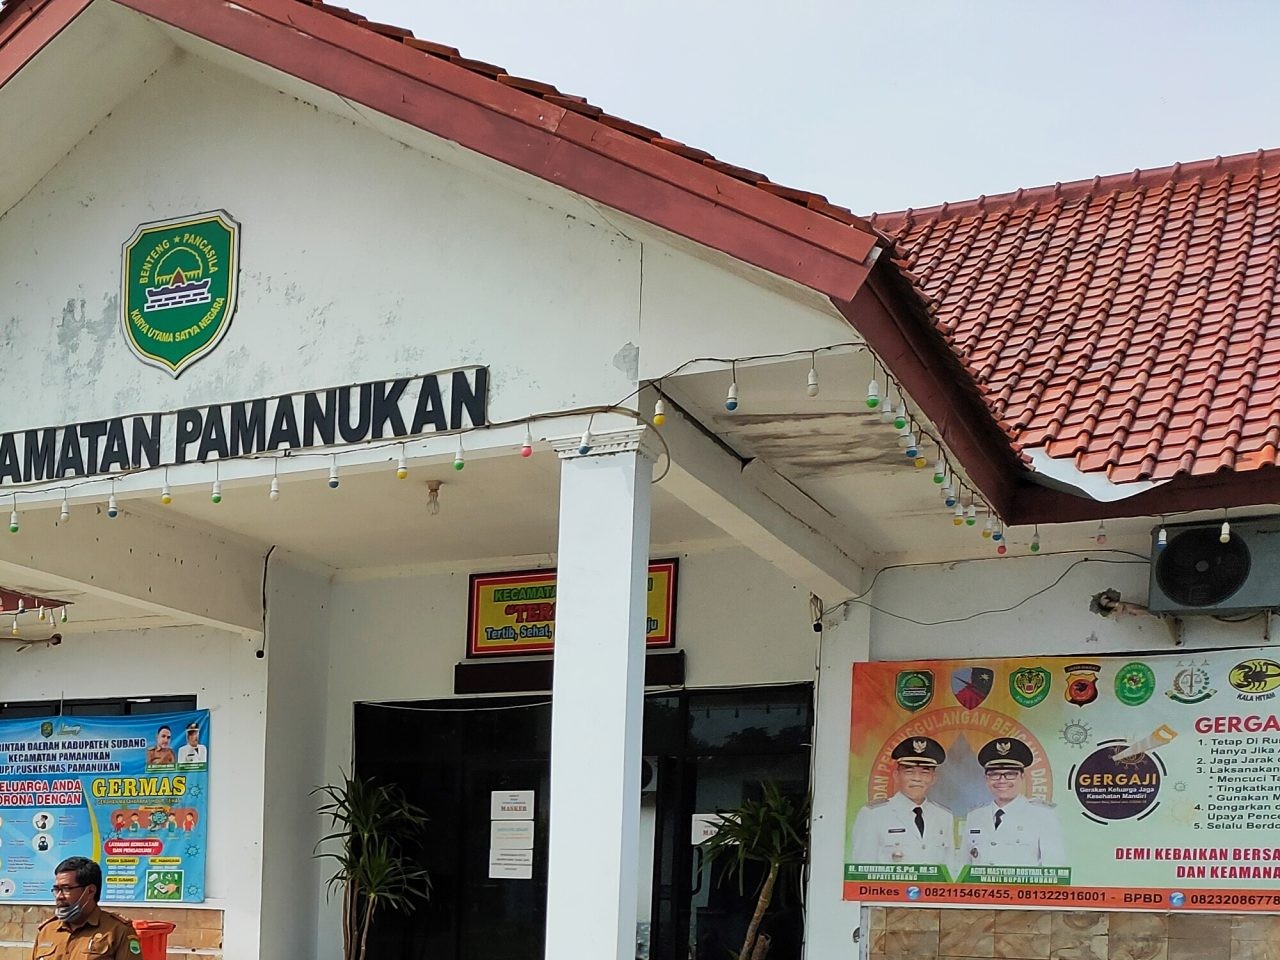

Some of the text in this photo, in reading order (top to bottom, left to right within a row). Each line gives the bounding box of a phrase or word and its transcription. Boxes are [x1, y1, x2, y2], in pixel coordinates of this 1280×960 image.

[139, 233, 218, 284] BENTENG PANCASILA
[130, 297, 225, 343] KARYA UTAMA SATYA NEGARA
[176, 367, 489, 462] PAMANUKAN
[494, 585, 556, 602] KECAMATA
[486, 626, 518, 641] Tertib,
[520, 624, 552, 639] Sehat,
[1236, 691, 1276, 701] KALA HITAM
[27, 741, 60, 751] DAERAH
[61, 740, 109, 750] KABUPATEN
[111, 738, 146, 749] SUBANG
[1211, 738, 1242, 747] Tetap
[8, 752, 111, 763] KECAMATAN PAMANUKAN
[1211, 748, 1246, 756] Hanya
[1210, 757, 1237, 767] Jaga
[1241, 756, 1273, 764] Jarak
[0, 762, 120, 774] UPT PUSKESMAS PAMANUKAN
[1210, 765, 1280, 774] Laksanakan
[1079, 774, 1157, 785] GERGAJI
[1217, 774, 1266, 783] Mencuci
[51, 780, 82, 791] ANDA
[92, 776, 187, 798] GERMAS
[873, 776, 888, 800] DAN
[1108, 786, 1137, 794] Keluarga
[37, 793, 82, 805] DENGAN
[1216, 793, 1269, 801] Gunakan
[1194, 803, 1204, 811] 4.
[1208, 803, 1271, 812] Dengarkan
[1207, 813, 1243, 821] Upaya
[1207, 822, 1243, 830] Selalu
[1115, 848, 1151, 860] DEMI
[1154, 848, 1228, 861] KEBAIKAN
[971, 867, 986, 875] AGUS
[987, 867, 1015, 875] MASYKUR
[1176, 866, 1206, 878] DAN
[1029, 876, 1057, 884] SUBANG
[859, 886, 900, 896] Dinkes
[924, 888, 1014, 901] 082115467455,
[1017, 889, 1106, 901] 081322916001
[1123, 893, 1163, 904] BPBD
